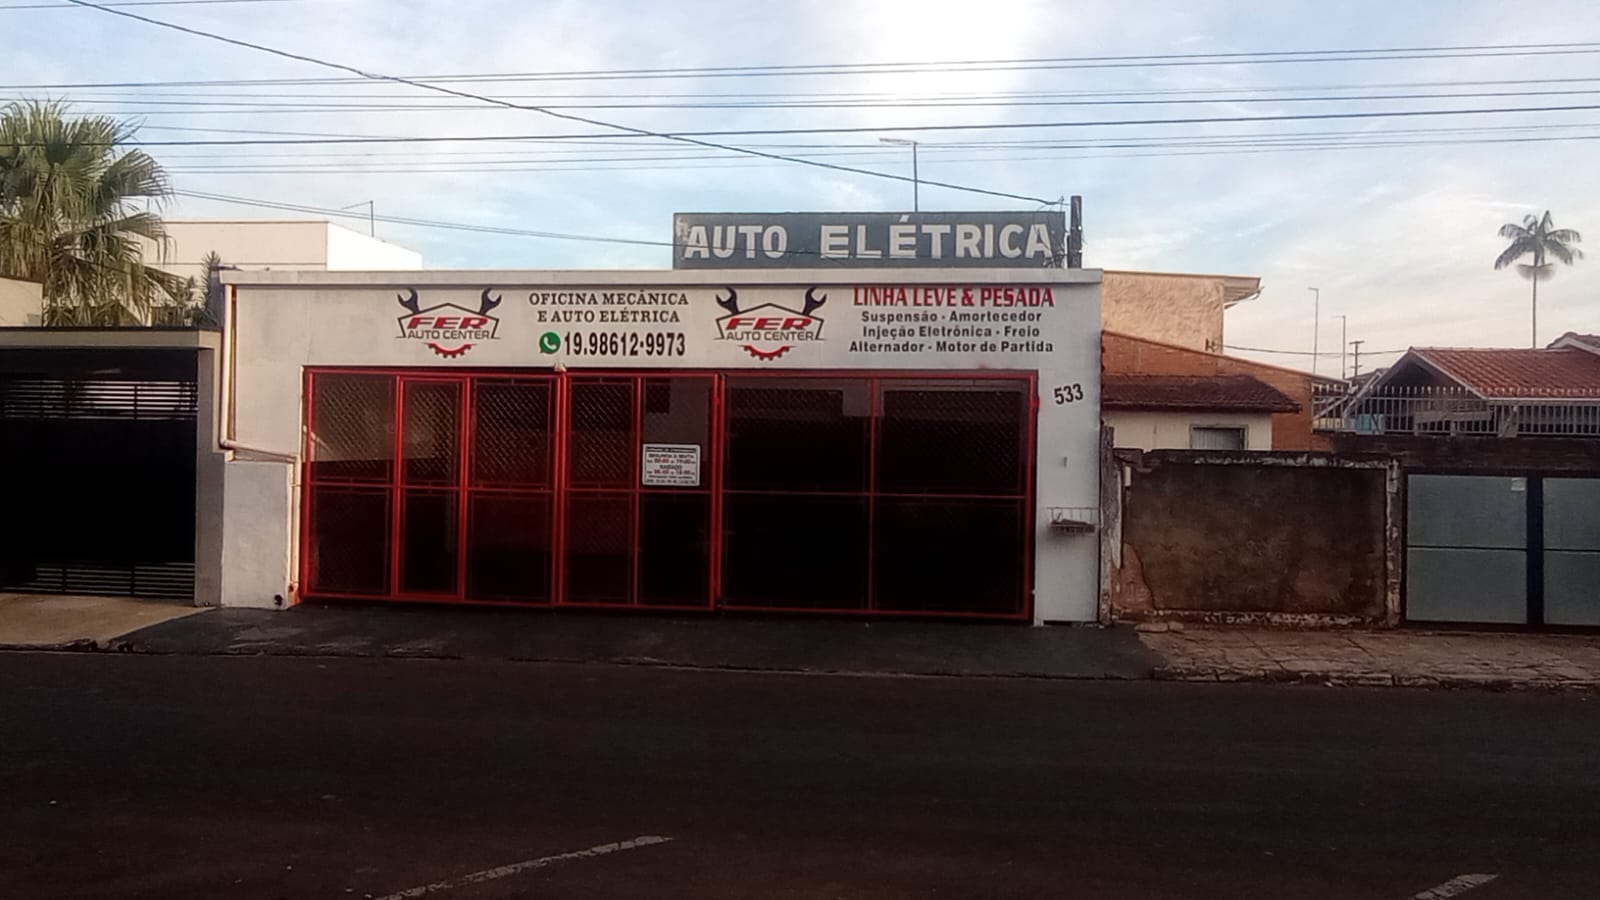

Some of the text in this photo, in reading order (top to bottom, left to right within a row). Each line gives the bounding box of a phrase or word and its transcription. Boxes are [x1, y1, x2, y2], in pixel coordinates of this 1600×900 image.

[683, 215, 1053, 260] AUTO ELÉTRICA
[528, 290, 689, 306] OFICINA MECÂNICA
[853, 286, 1055, 308] LINHA LEVE & PESADA
[407, 316, 489, 330] FER
[537, 307, 680, 323] E AUTO ELÉTRICA
[861, 310, 938, 325] Suspensão
[949, 310, 1042, 322] Amortecedor
[725, 317, 812, 331] FER
[863, 325, 915, 340] Injeção
[919, 324, 992, 338] Eletrônica
[1004, 325, 1040, 338] Freio
[407, 330, 490, 341] AUTO CENTER
[564, 331, 685, 356] 19.98612-9973
[725, 330, 814, 341] AUTO CENTER
[849, 340, 925, 353] Alternador
[936, 340, 977, 353] Motor
[980, 340, 997, 353] de
[1000, 340, 1053, 353] Partida
[1054, 382, 1084, 406] 533
